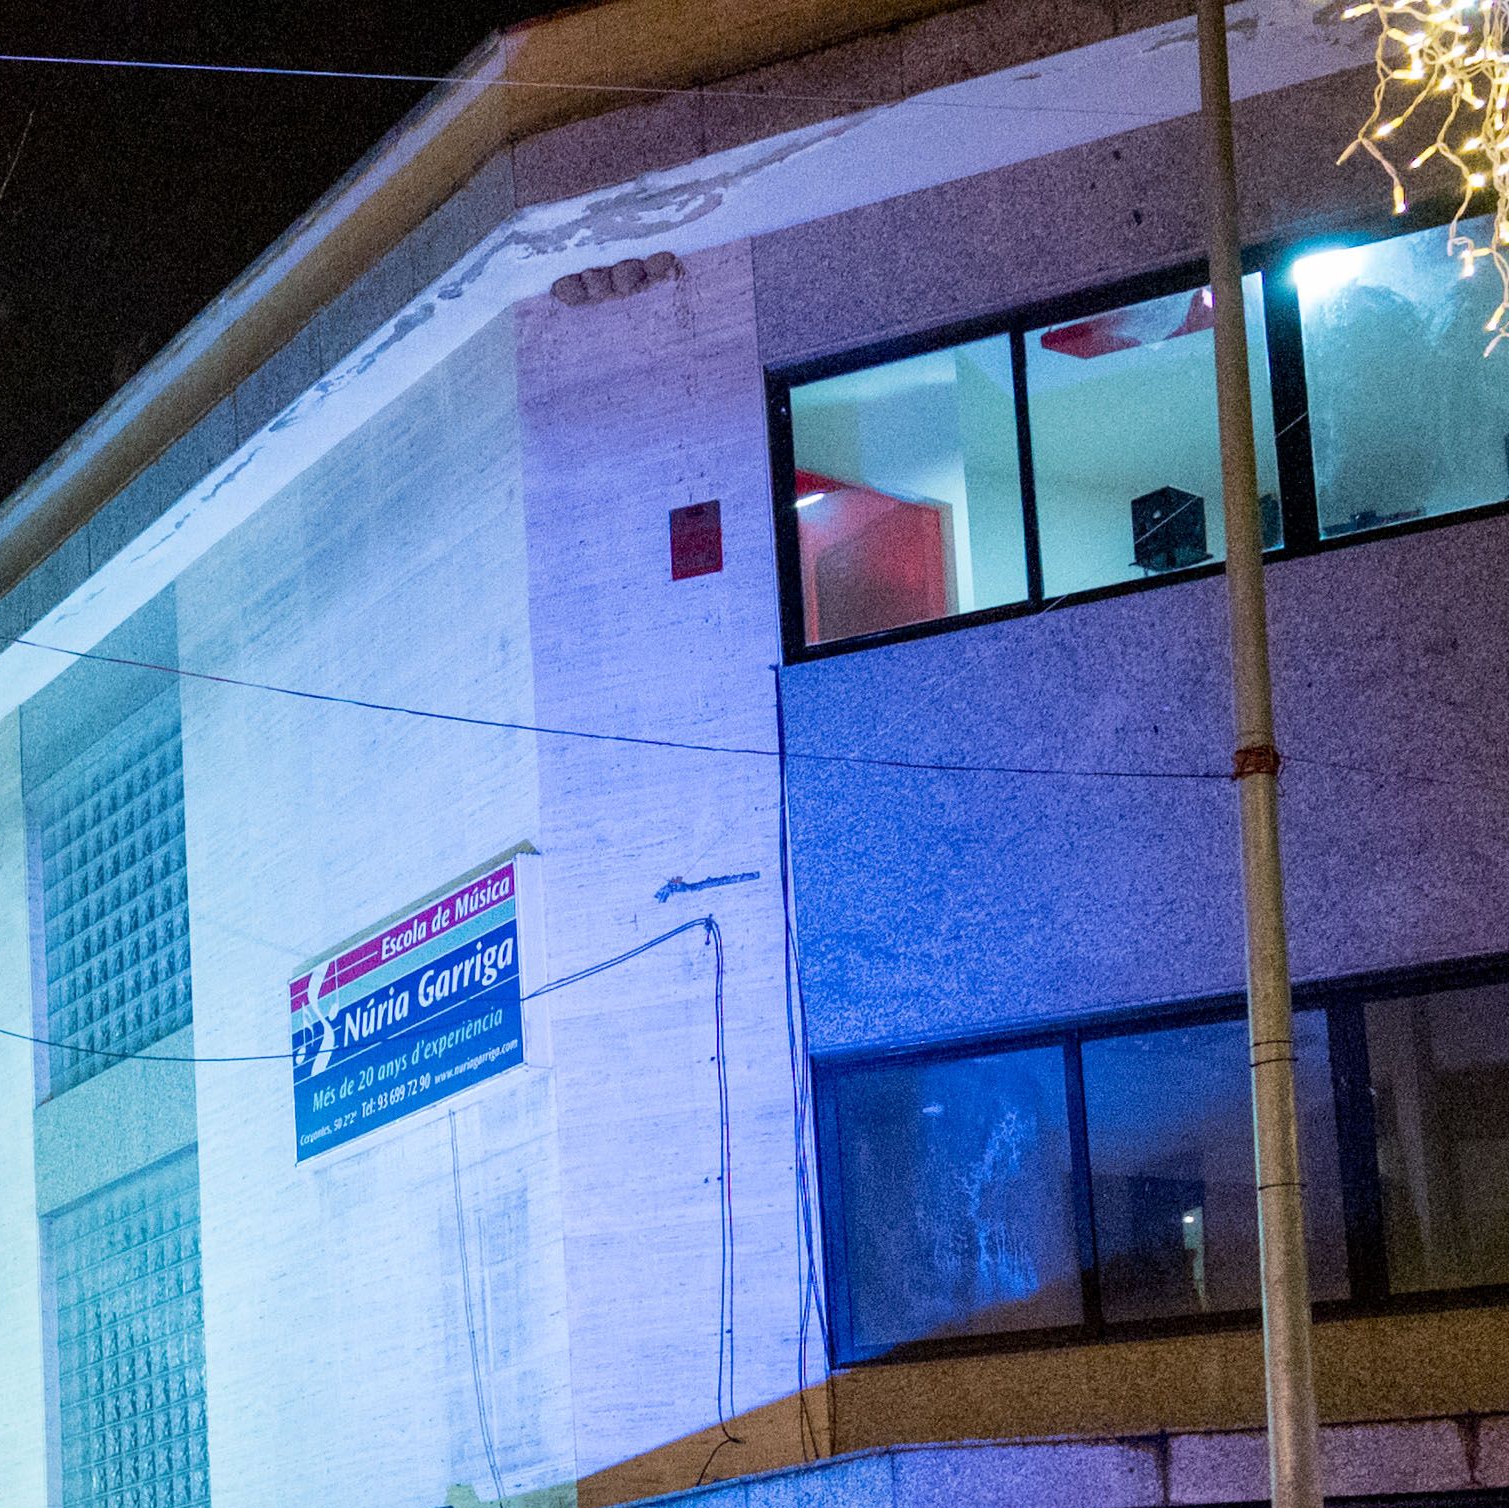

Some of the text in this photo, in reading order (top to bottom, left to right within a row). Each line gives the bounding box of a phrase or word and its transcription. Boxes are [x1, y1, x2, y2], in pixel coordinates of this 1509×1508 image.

[381, 876, 510, 960] Escola de Música
[344, 937, 514, 1047] Núria Garriga
[312, 1082, 336, 1112] Més
[339, 1076, 355, 1098] de
[357, 1066, 373, 1091] 20
[377, 1055, 407, 1080] anys
[361, 1100, 376, 1118] Tel:
[377, 1094, 389, 1112] 93
[389, 1085, 406, 1105] 699
[407, 1080, 418, 1098] 72
[419, 1073, 432, 1090] 90
[434, 1038, 519, 1084] www.nuriagarriga.com
